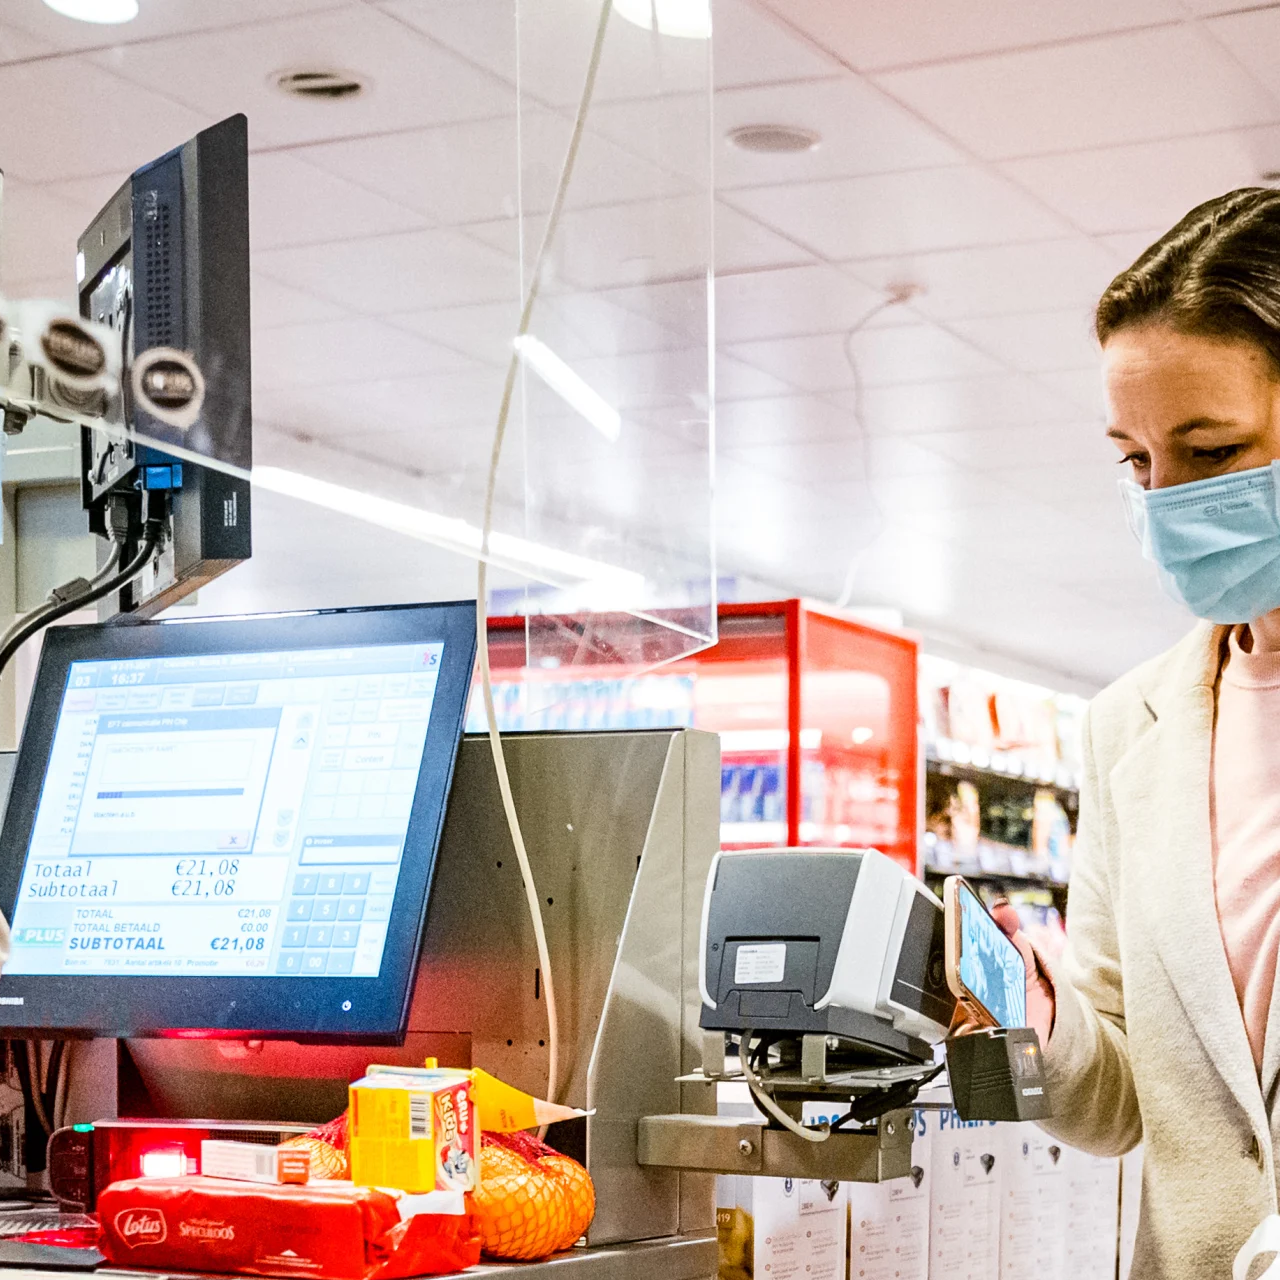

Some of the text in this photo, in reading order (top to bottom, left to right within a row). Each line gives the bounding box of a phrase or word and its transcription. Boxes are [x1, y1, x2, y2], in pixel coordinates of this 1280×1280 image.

[34, 859, 240, 878] Totaal €21,08
[28, 879, 236, 899] Subtotaal €21,08
[303, 878, 311, 889] 7
[328, 878, 337, 889] 8
[77, 909, 113, 919] TOTAAL
[297, 904, 356, 915] 4 5 6
[73, 923, 110, 933] TOTAAL
[114, 923, 161, 933] BETAALD
[25, 929, 65, 942] PLUS
[292, 931, 350, 941] 1 2 3
[69, 937, 265, 954] SUBTOTAAL €21,08
[123, 1213, 162, 1237] Lotus
